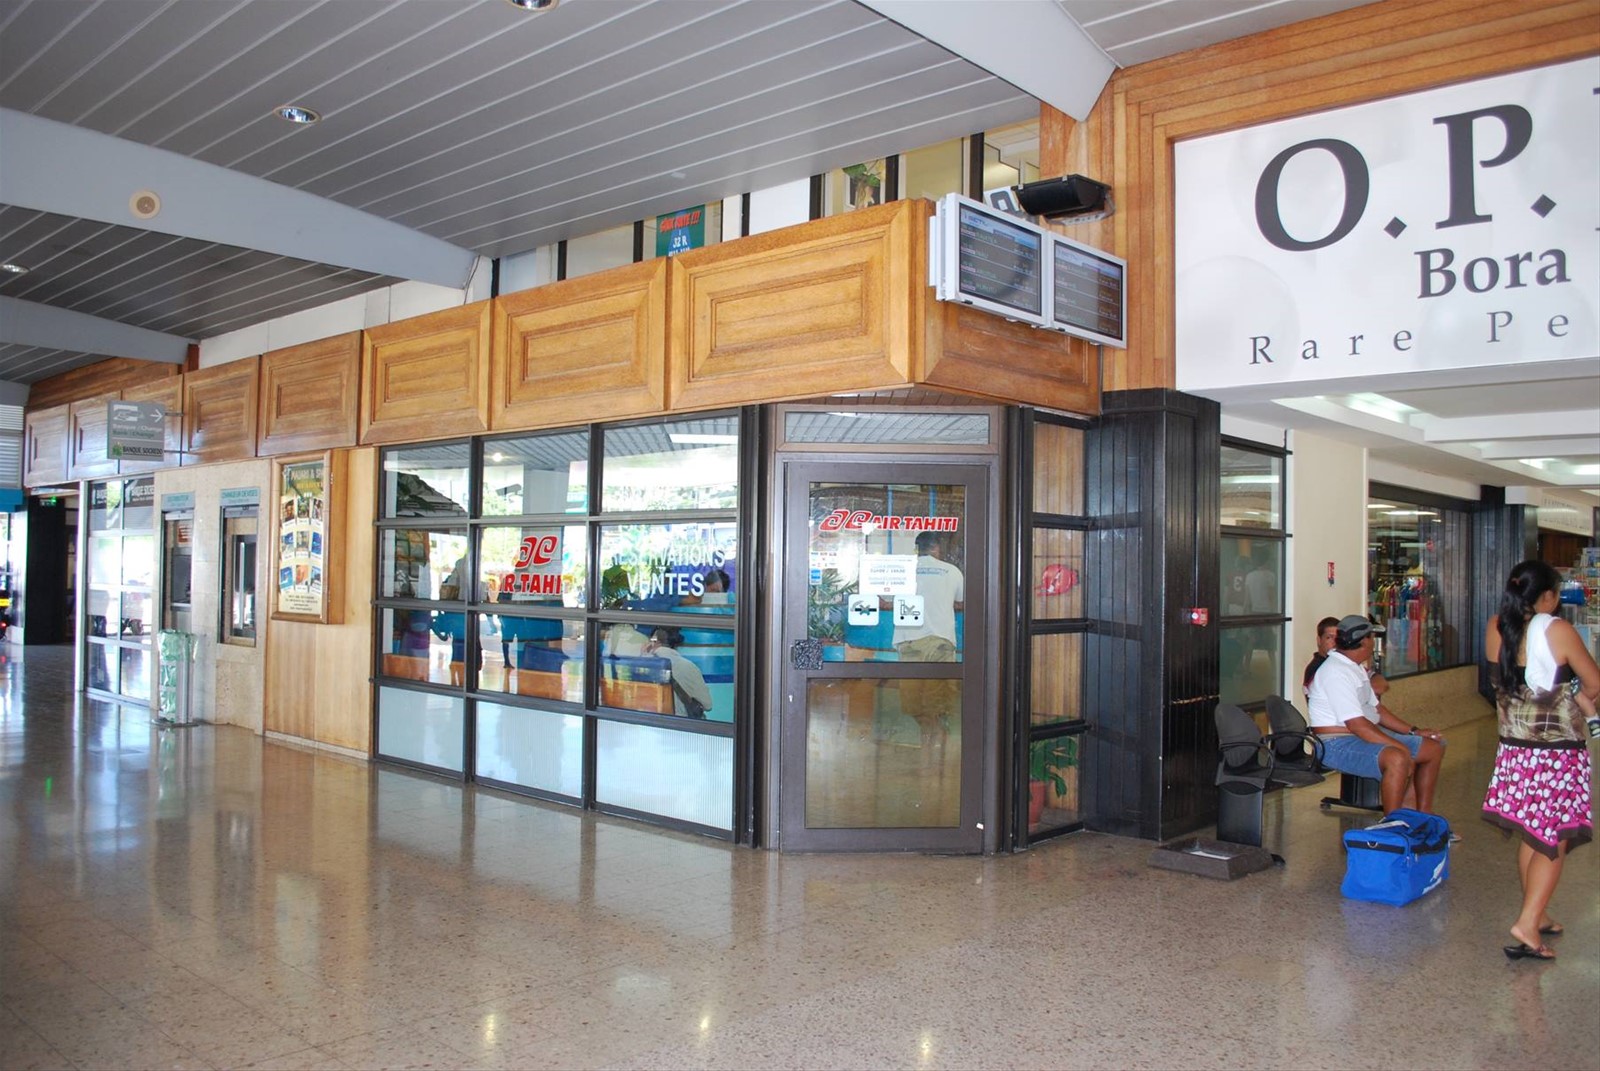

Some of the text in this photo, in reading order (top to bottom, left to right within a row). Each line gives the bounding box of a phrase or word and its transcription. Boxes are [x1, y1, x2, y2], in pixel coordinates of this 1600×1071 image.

[1254, 86, 1600, 252] O.P.
[672, 235, 688, 249] 32 R
[1414, 247, 1571, 299] Bora
[1249, 311, 1570, 365] Rare Pe
[872, 515, 959, 533] AIR TAHITI
[608, 545, 726, 568] SVATIONS
